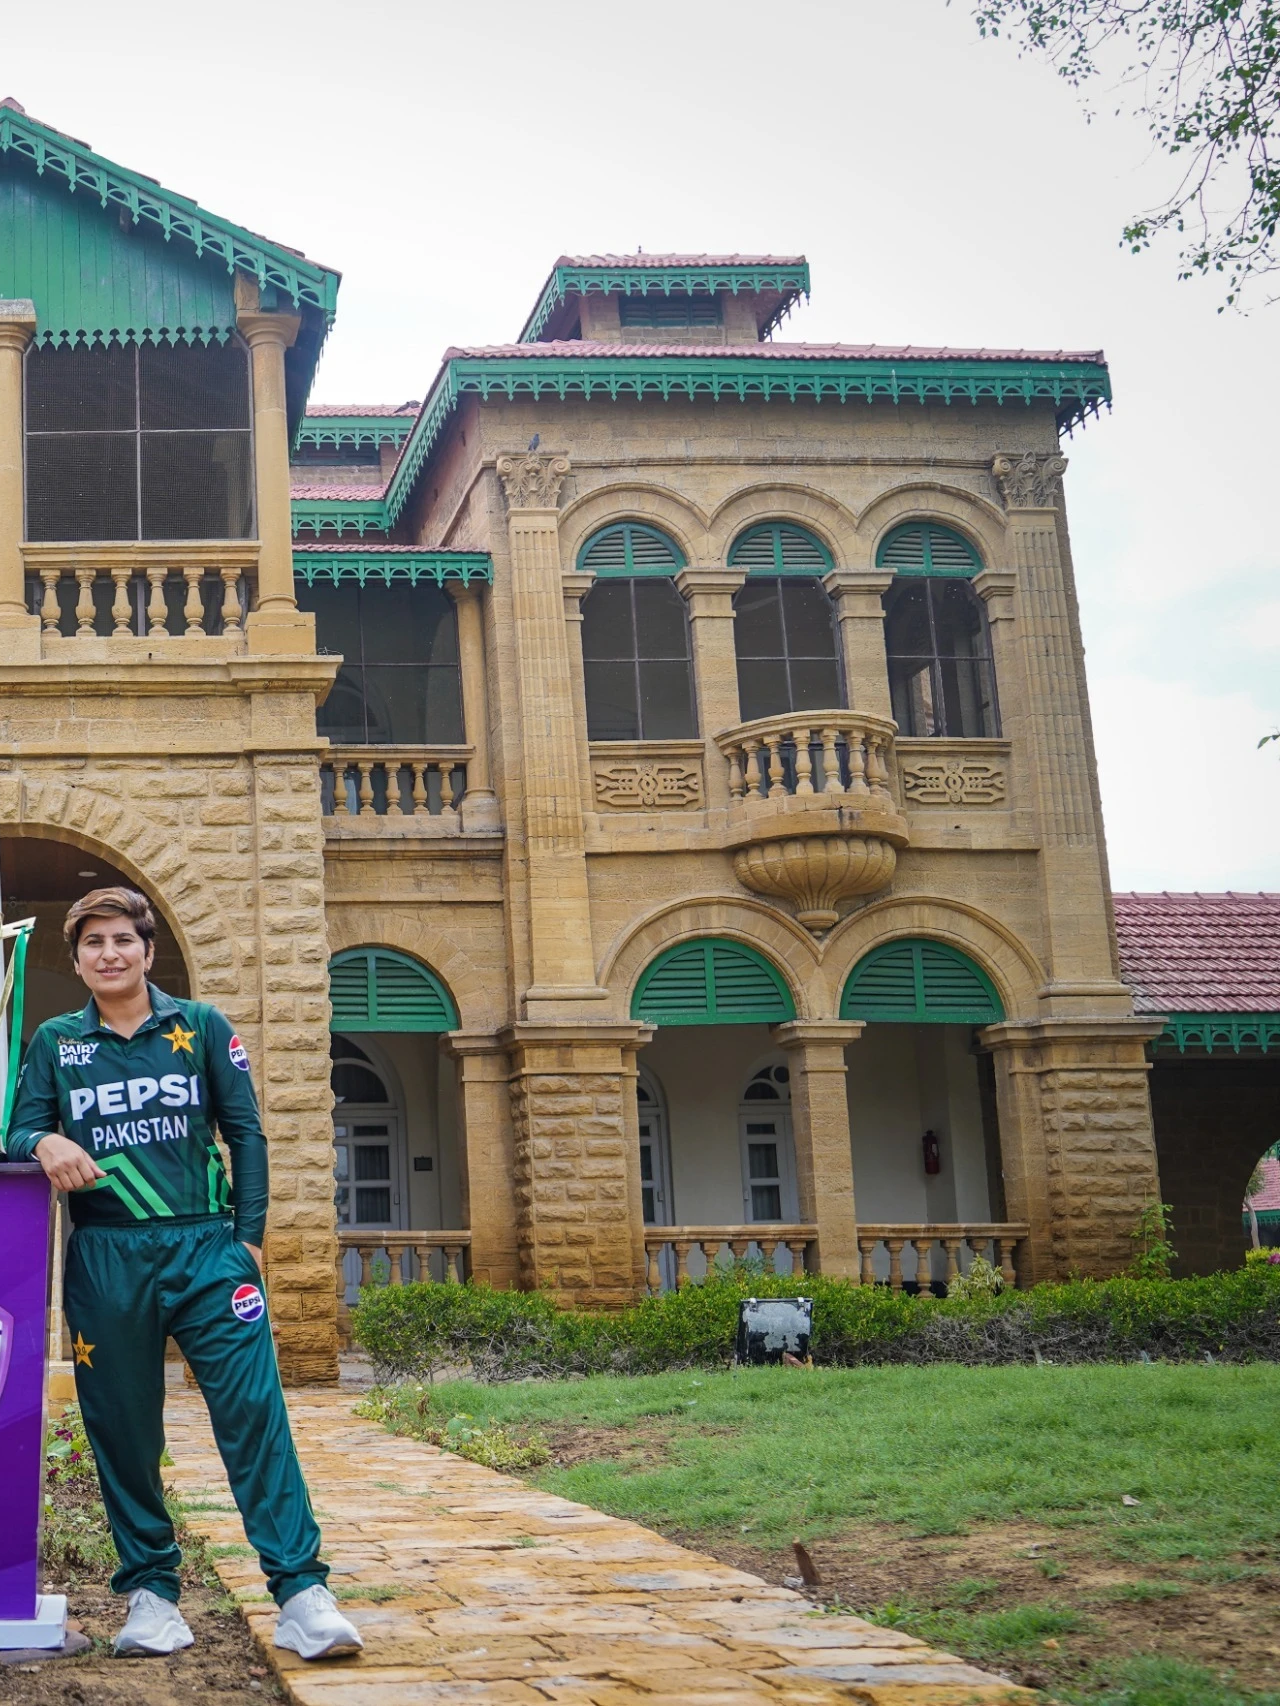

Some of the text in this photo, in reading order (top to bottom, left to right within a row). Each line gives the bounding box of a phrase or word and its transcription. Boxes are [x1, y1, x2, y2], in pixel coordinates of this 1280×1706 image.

[59, 1042, 100, 1056] DAIRY
[60, 1053, 93, 1067] MILK
[69, 1073, 200, 1121] PEPSI
[91, 1115, 188, 1151] PAKISTAN
[235, 1296, 261, 1310] PEPSI
